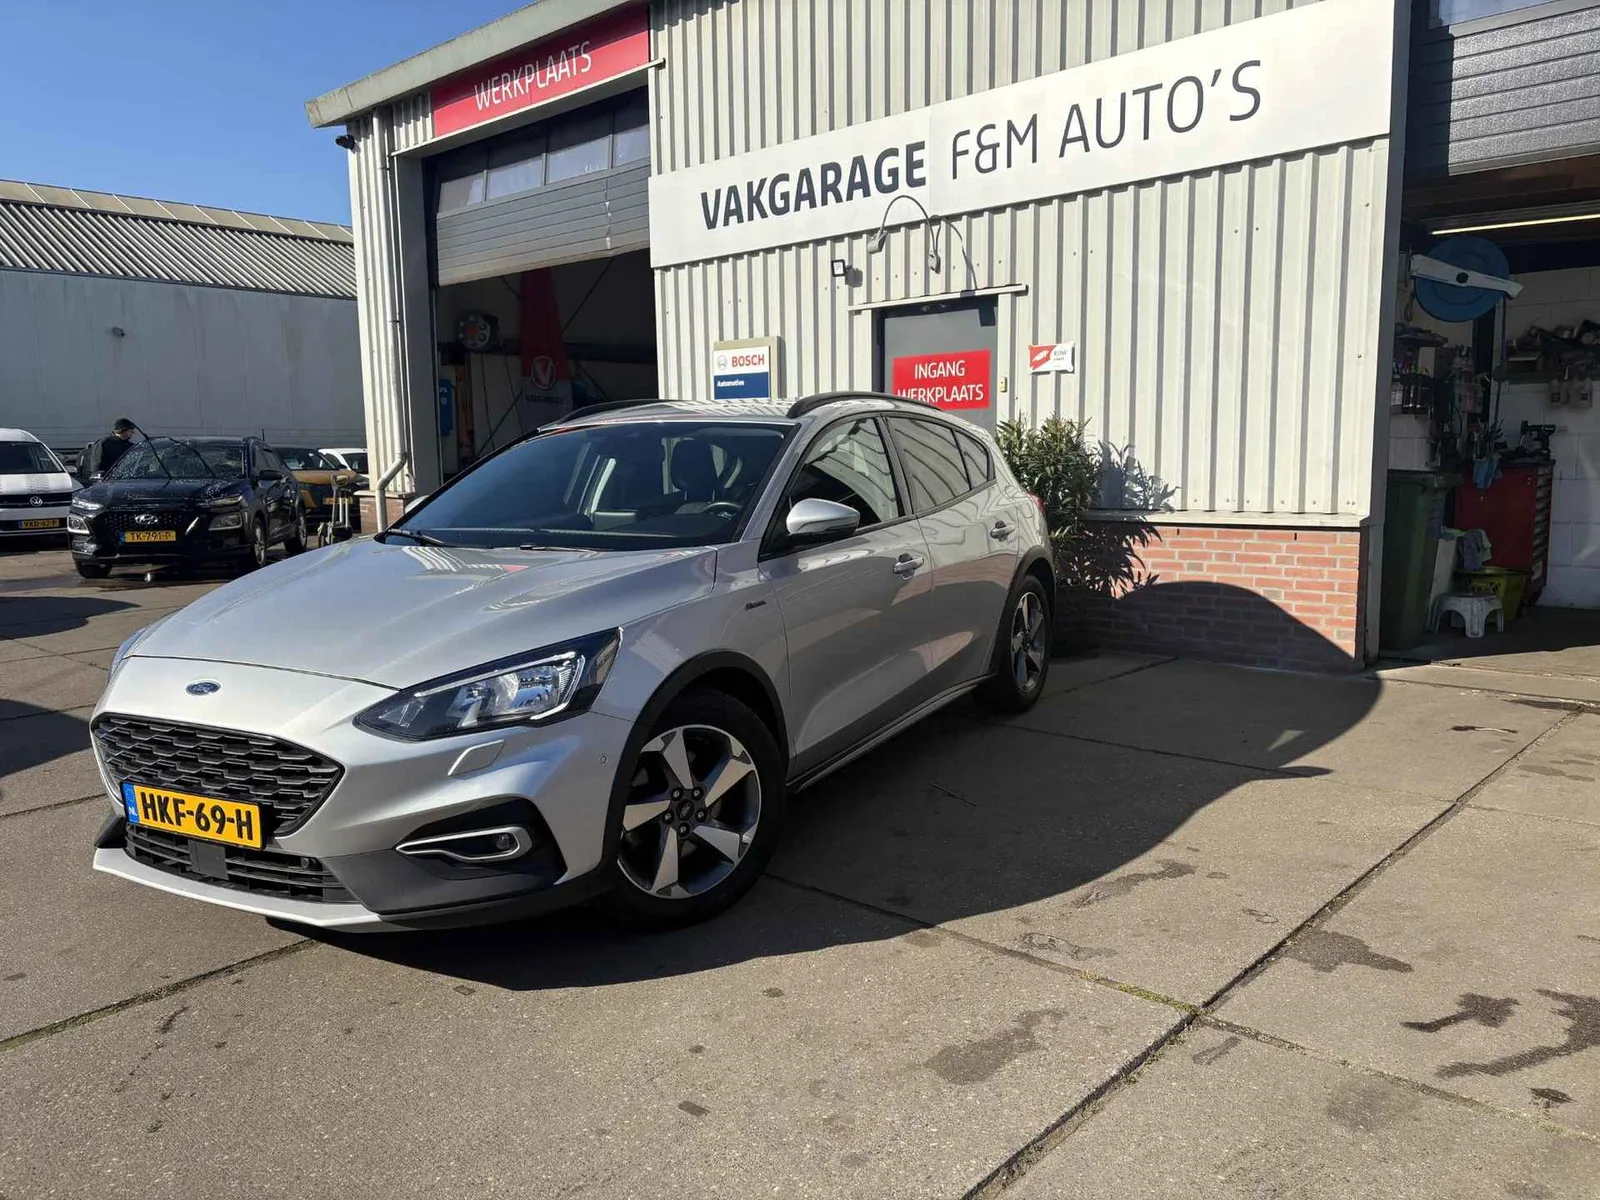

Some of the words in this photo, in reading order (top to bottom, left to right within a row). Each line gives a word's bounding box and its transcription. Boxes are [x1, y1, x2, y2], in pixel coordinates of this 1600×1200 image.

[474, 41, 592, 111] WERKPLAATS
[700, 140, 927, 230] VAKGARAGE
[952, 113, 1038, 180] F&M
[1058, 60, 1261, 158] AUTO'S
[731, 354, 765, 367] BOSCH
[914, 360, 966, 379] INGANG
[140, 790, 254, 841] HKF-69-H
